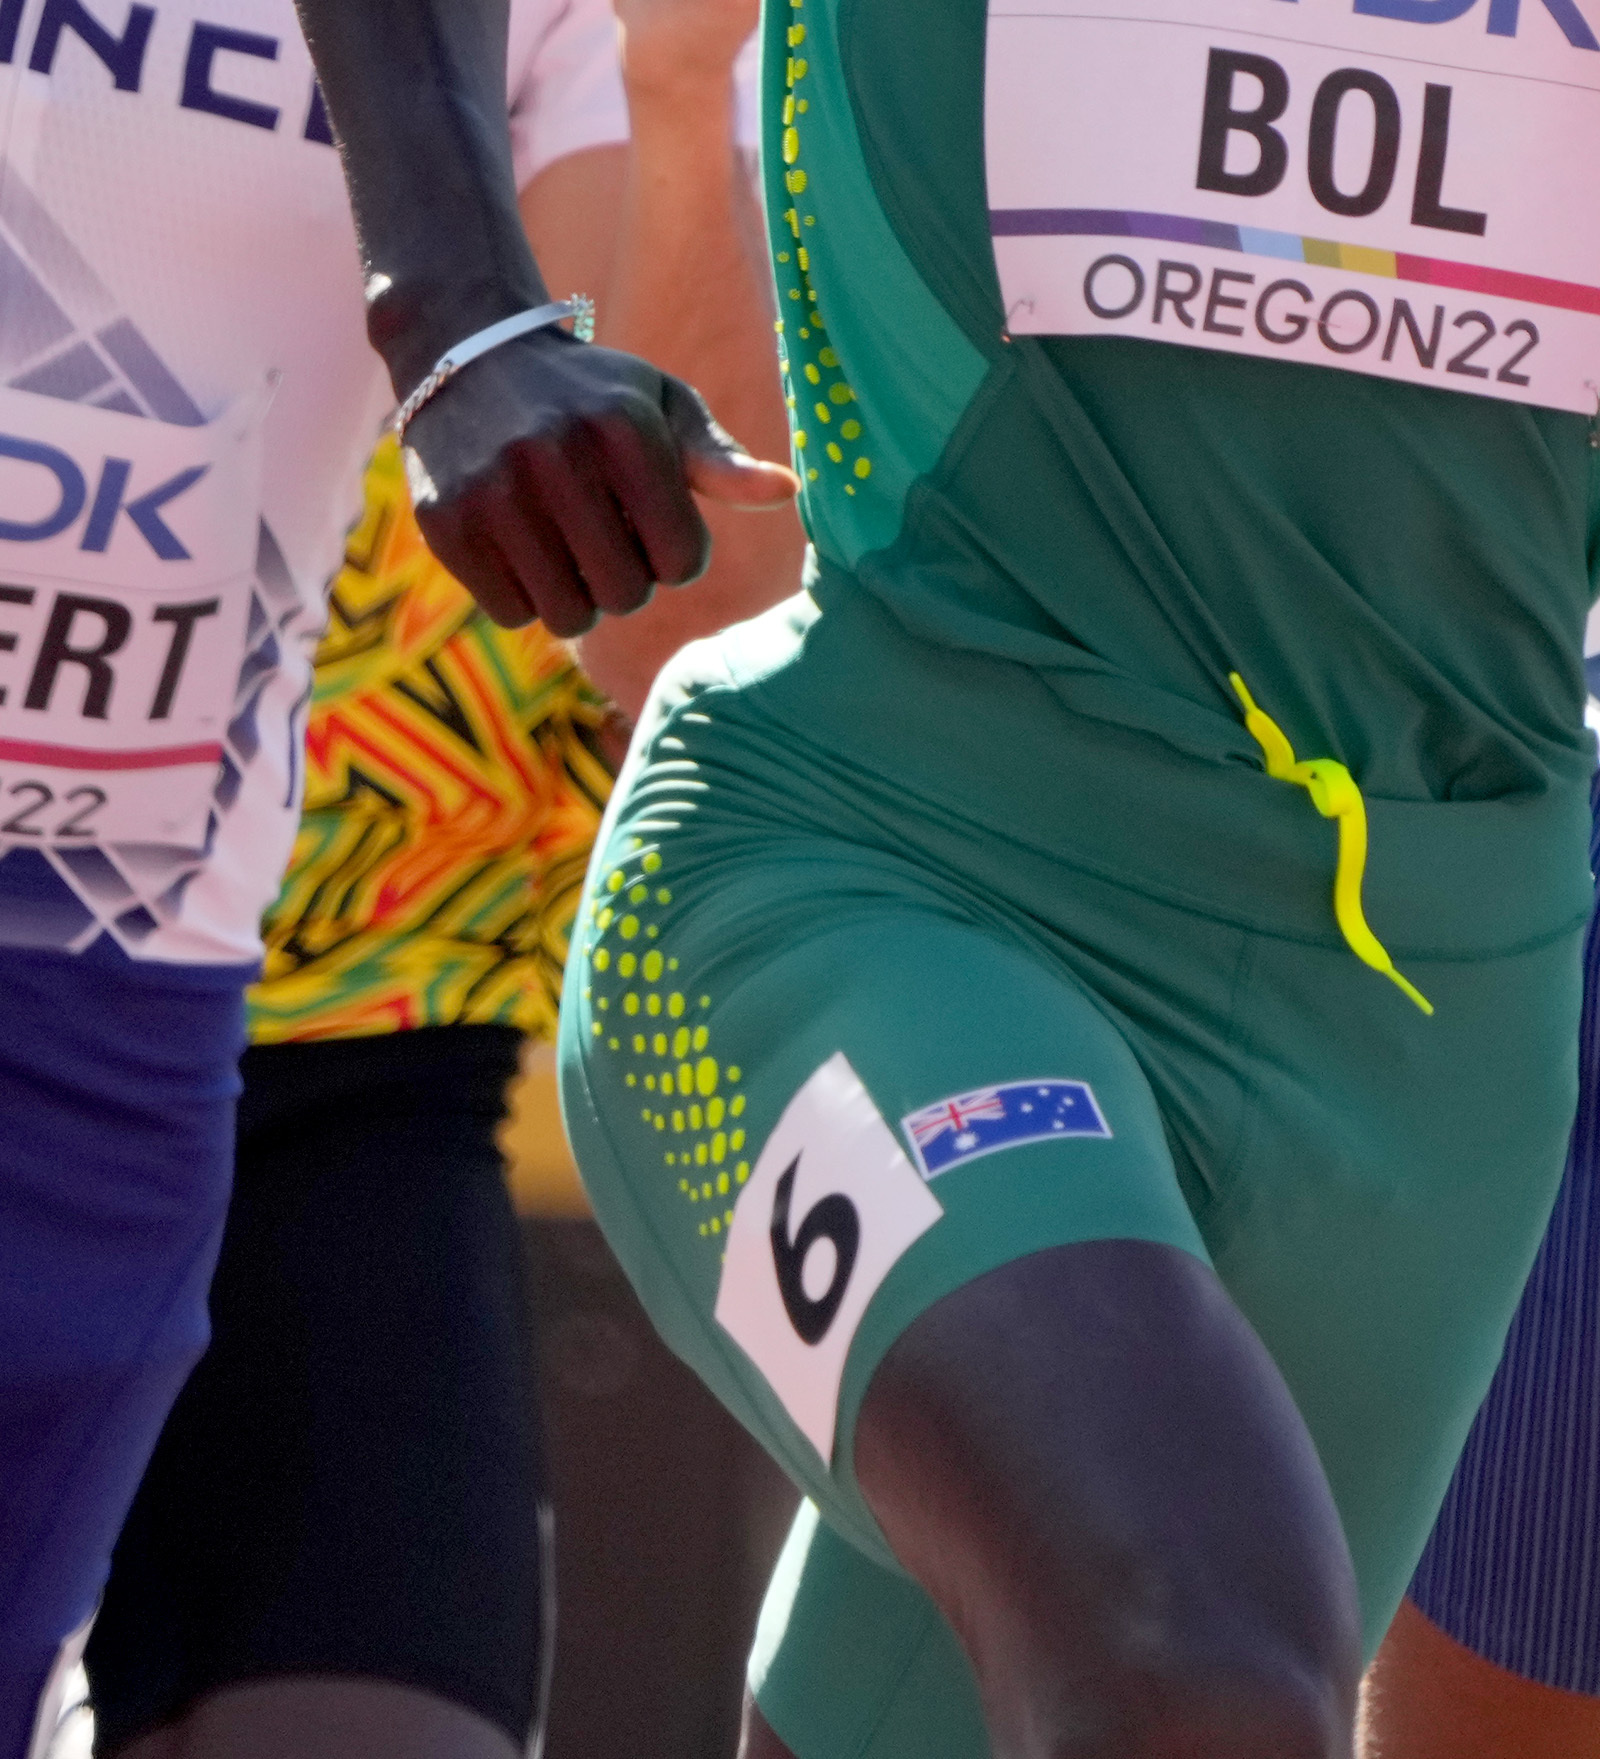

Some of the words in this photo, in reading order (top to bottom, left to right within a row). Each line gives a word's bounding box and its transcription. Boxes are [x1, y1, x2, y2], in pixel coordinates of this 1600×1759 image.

[1196, 47, 1487, 237] BOL
[1083, 253, 1540, 386] OREGON22
[769, 1145, 860, 1347] 6
